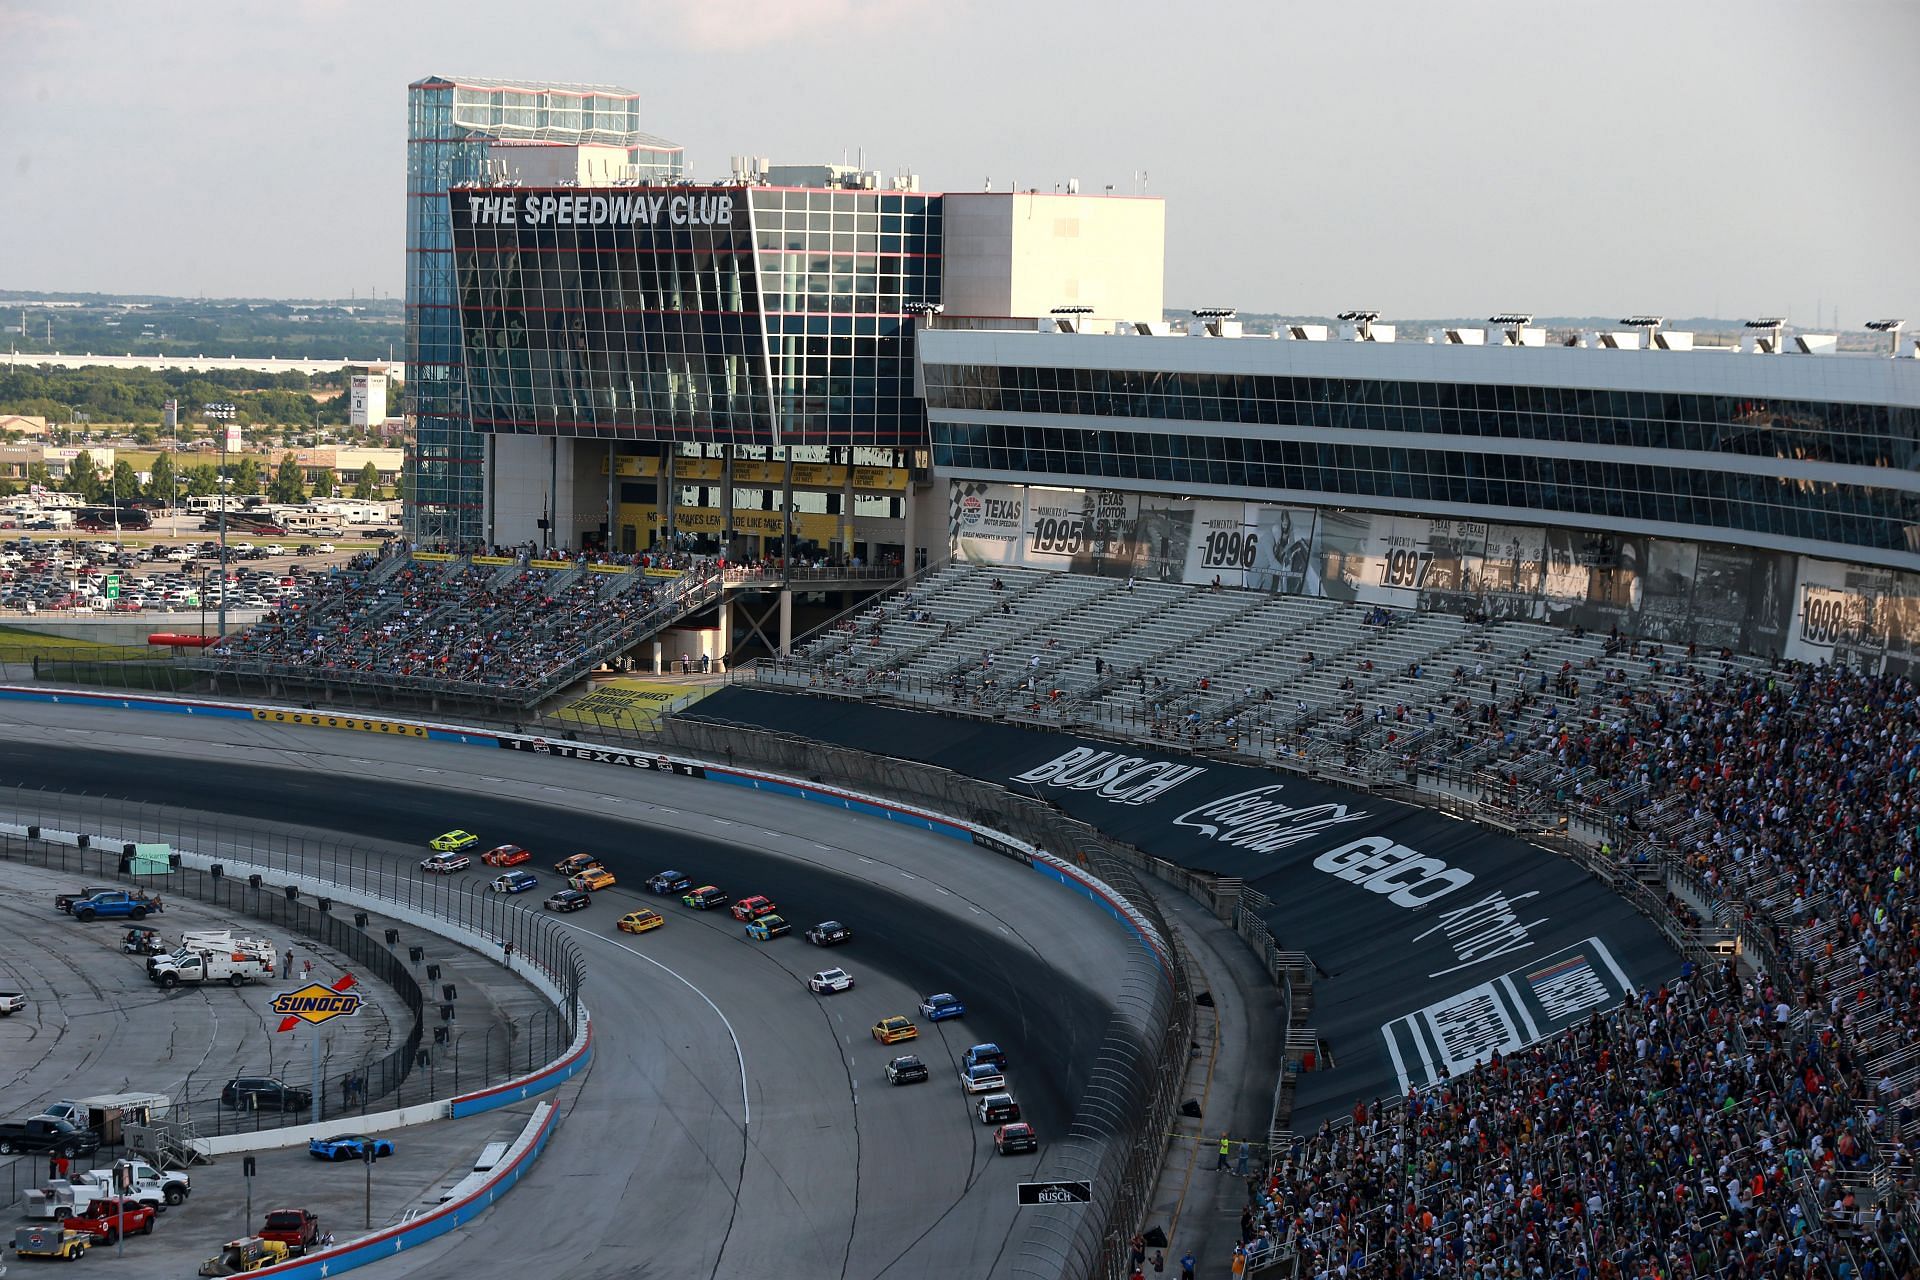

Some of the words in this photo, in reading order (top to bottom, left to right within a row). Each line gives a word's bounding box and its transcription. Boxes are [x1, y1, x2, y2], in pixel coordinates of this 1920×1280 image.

[468, 196, 516, 224] THE
[524, 196, 664, 225] SPEEDWAY
[669, 196, 733, 225] CLUB
[1097, 493, 1124, 506] TEXAS
[985, 499, 1021, 519] TEXAS
[1038, 506, 1061, 517] MOMENTS
[1062, 508, 1068, 517] IN
[1097, 506, 1126, 519] MOTOR
[679, 513, 704, 525] MAKES
[747, 516, 763, 528] LIKE
[984, 518, 998, 526] MOTOR
[1208, 519, 1232, 529] MOMENTS
[976, 531, 995, 540] MOMENTS
[1034, 518, 1083, 553] 1995
[1466, 524, 1484, 534] TEXAS
[1387, 535, 1410, 547] MOMENTS
[1205, 531, 1258, 568] 1996
[1384, 548, 1434, 588] 1997
[1803, 597, 1842, 643] 1998
[512, 741, 520, 749] 1
[557, 746, 650, 768] TEXAS
[684, 766, 692, 775] 1
[1009, 746, 1208, 806] BUSCH
[1313, 836, 1475, 908] GEICO
[1531, 965, 1610, 1021] NASCAR
[277, 997, 356, 1012] SUNOCO
[1038, 1191, 1071, 1203] BUSCH
